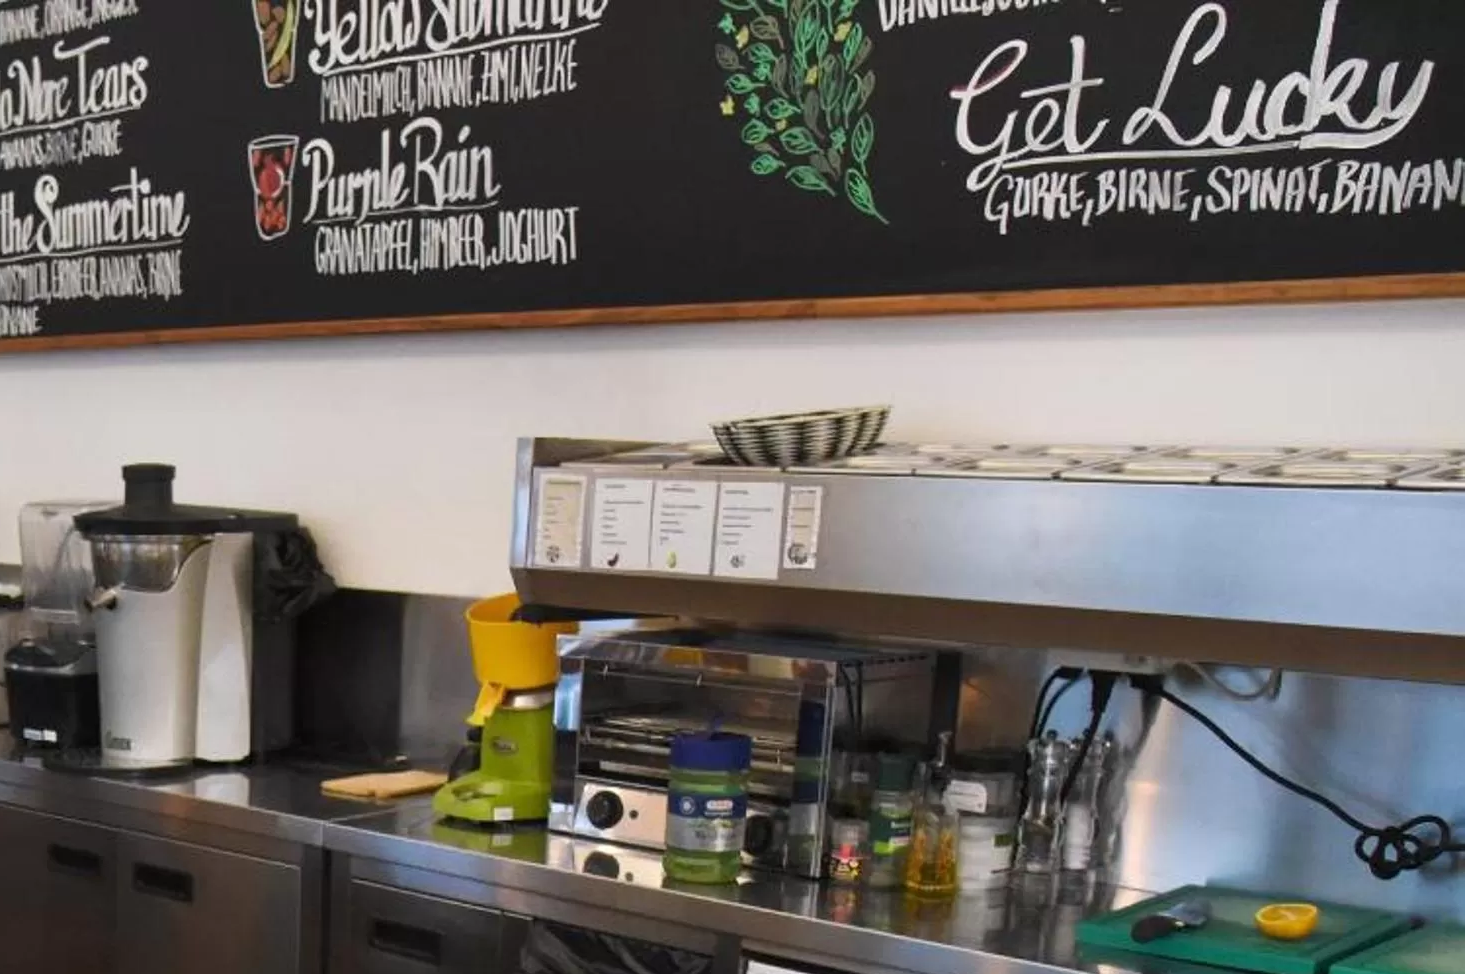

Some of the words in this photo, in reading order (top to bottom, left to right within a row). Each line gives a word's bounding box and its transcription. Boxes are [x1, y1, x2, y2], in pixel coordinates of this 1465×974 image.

[7, 55, 72, 125] More
[52, 36, 149, 116] Tears
[519, 39, 578, 100] NELKE
[950, 36, 1111, 192] Get
[1122, 0, 1436, 150] Lucky
[34, 167, 191, 253] Summertime
[302, 128, 410, 226] Purple
[400, 117, 502, 211] Rain
[982, 170, 1093, 236] GURKE,
[1094, 168, 1202, 222] BIRNE,
[1205, 158, 1332, 214] SPINAT,
[491, 206, 579, 265] JOGHURT
